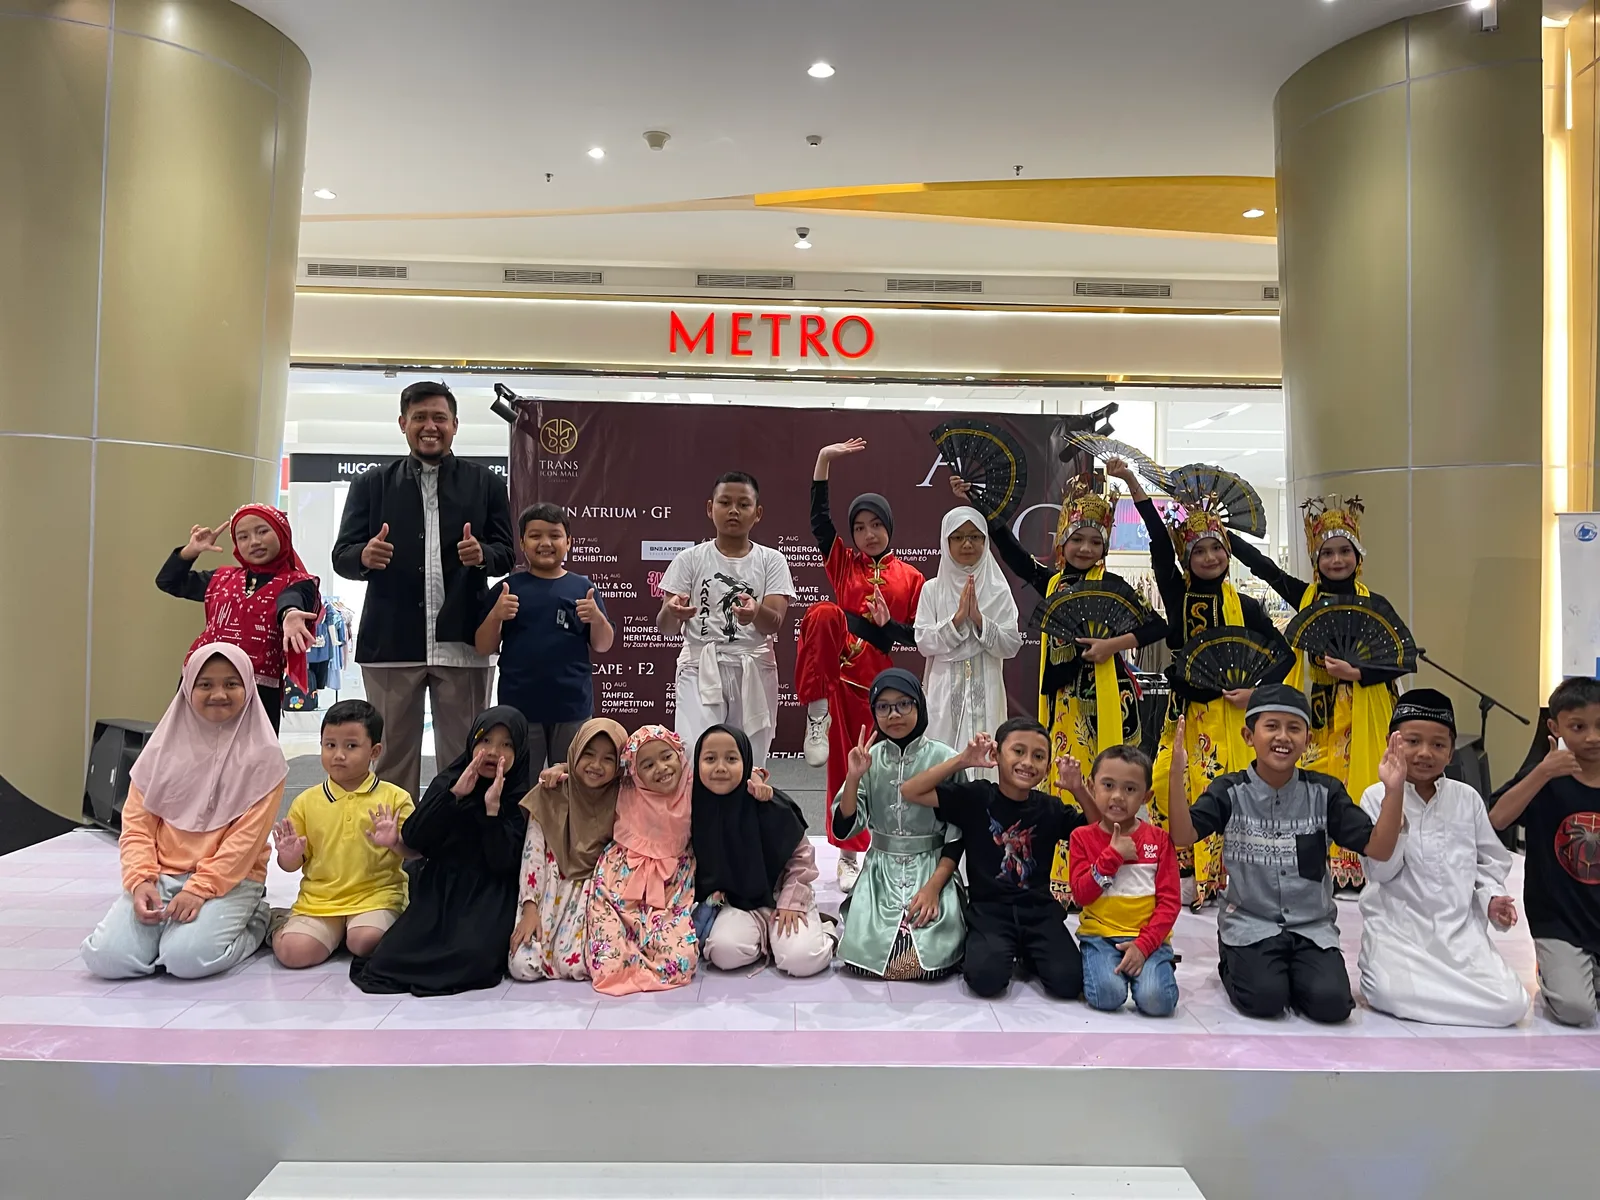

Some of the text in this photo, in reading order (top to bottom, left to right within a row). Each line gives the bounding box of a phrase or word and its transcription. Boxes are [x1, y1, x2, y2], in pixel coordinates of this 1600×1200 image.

[669, 310, 875, 358] METRO
[538, 460, 579, 470] TRANS
[581, 506, 637, 518] ATRIUM
[651, 506, 672, 518] GF
[778, 535, 784, 544] 2
[572, 546, 601, 554] METRO
[572, 555, 618, 563] EXHIBITION
[820, 594, 830, 602] 02
[699, 579, 711, 636] KARATE
[623, 616, 633, 625] 17
[623, 634, 662, 642] HERITAGE
[637, 662, 655, 675] F2
[601, 681, 612, 690] 10
[601, 691, 635, 699] TAHFIDZ
[601, 700, 655, 708] COMPETITION
